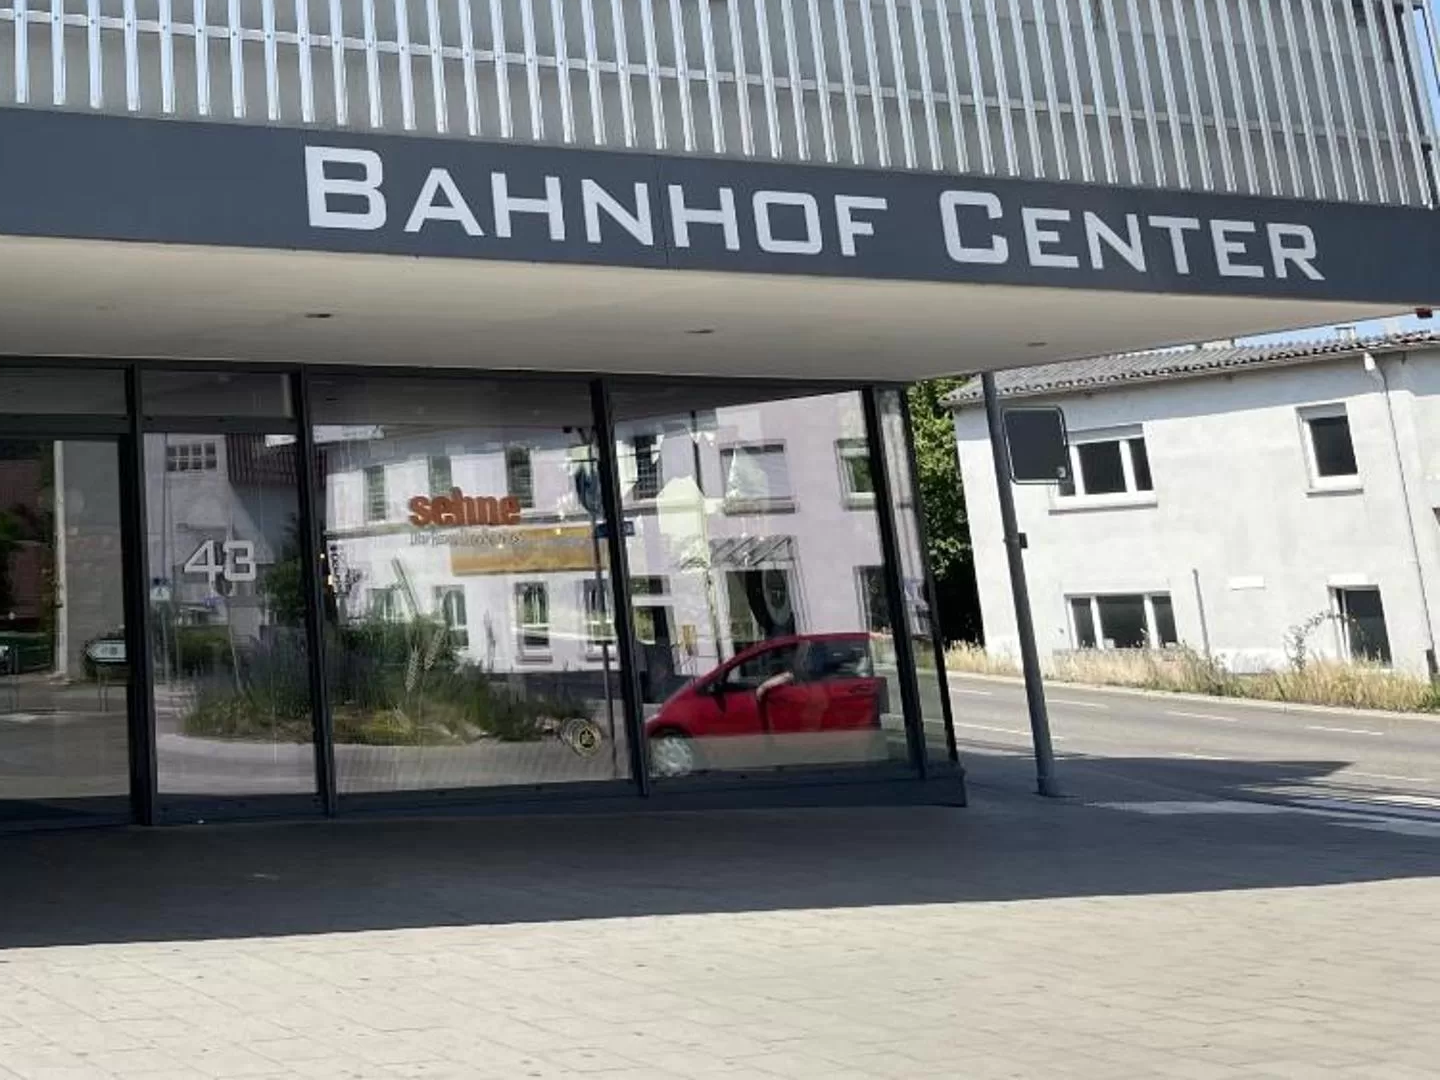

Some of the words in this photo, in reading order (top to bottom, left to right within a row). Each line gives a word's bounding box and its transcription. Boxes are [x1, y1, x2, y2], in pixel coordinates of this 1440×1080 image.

[304, 145, 888, 258] BAHNHOF
[938, 189, 1326, 281] CENTER
[407, 485, 521, 528] sehne
[184, 540, 257, 582] 43
